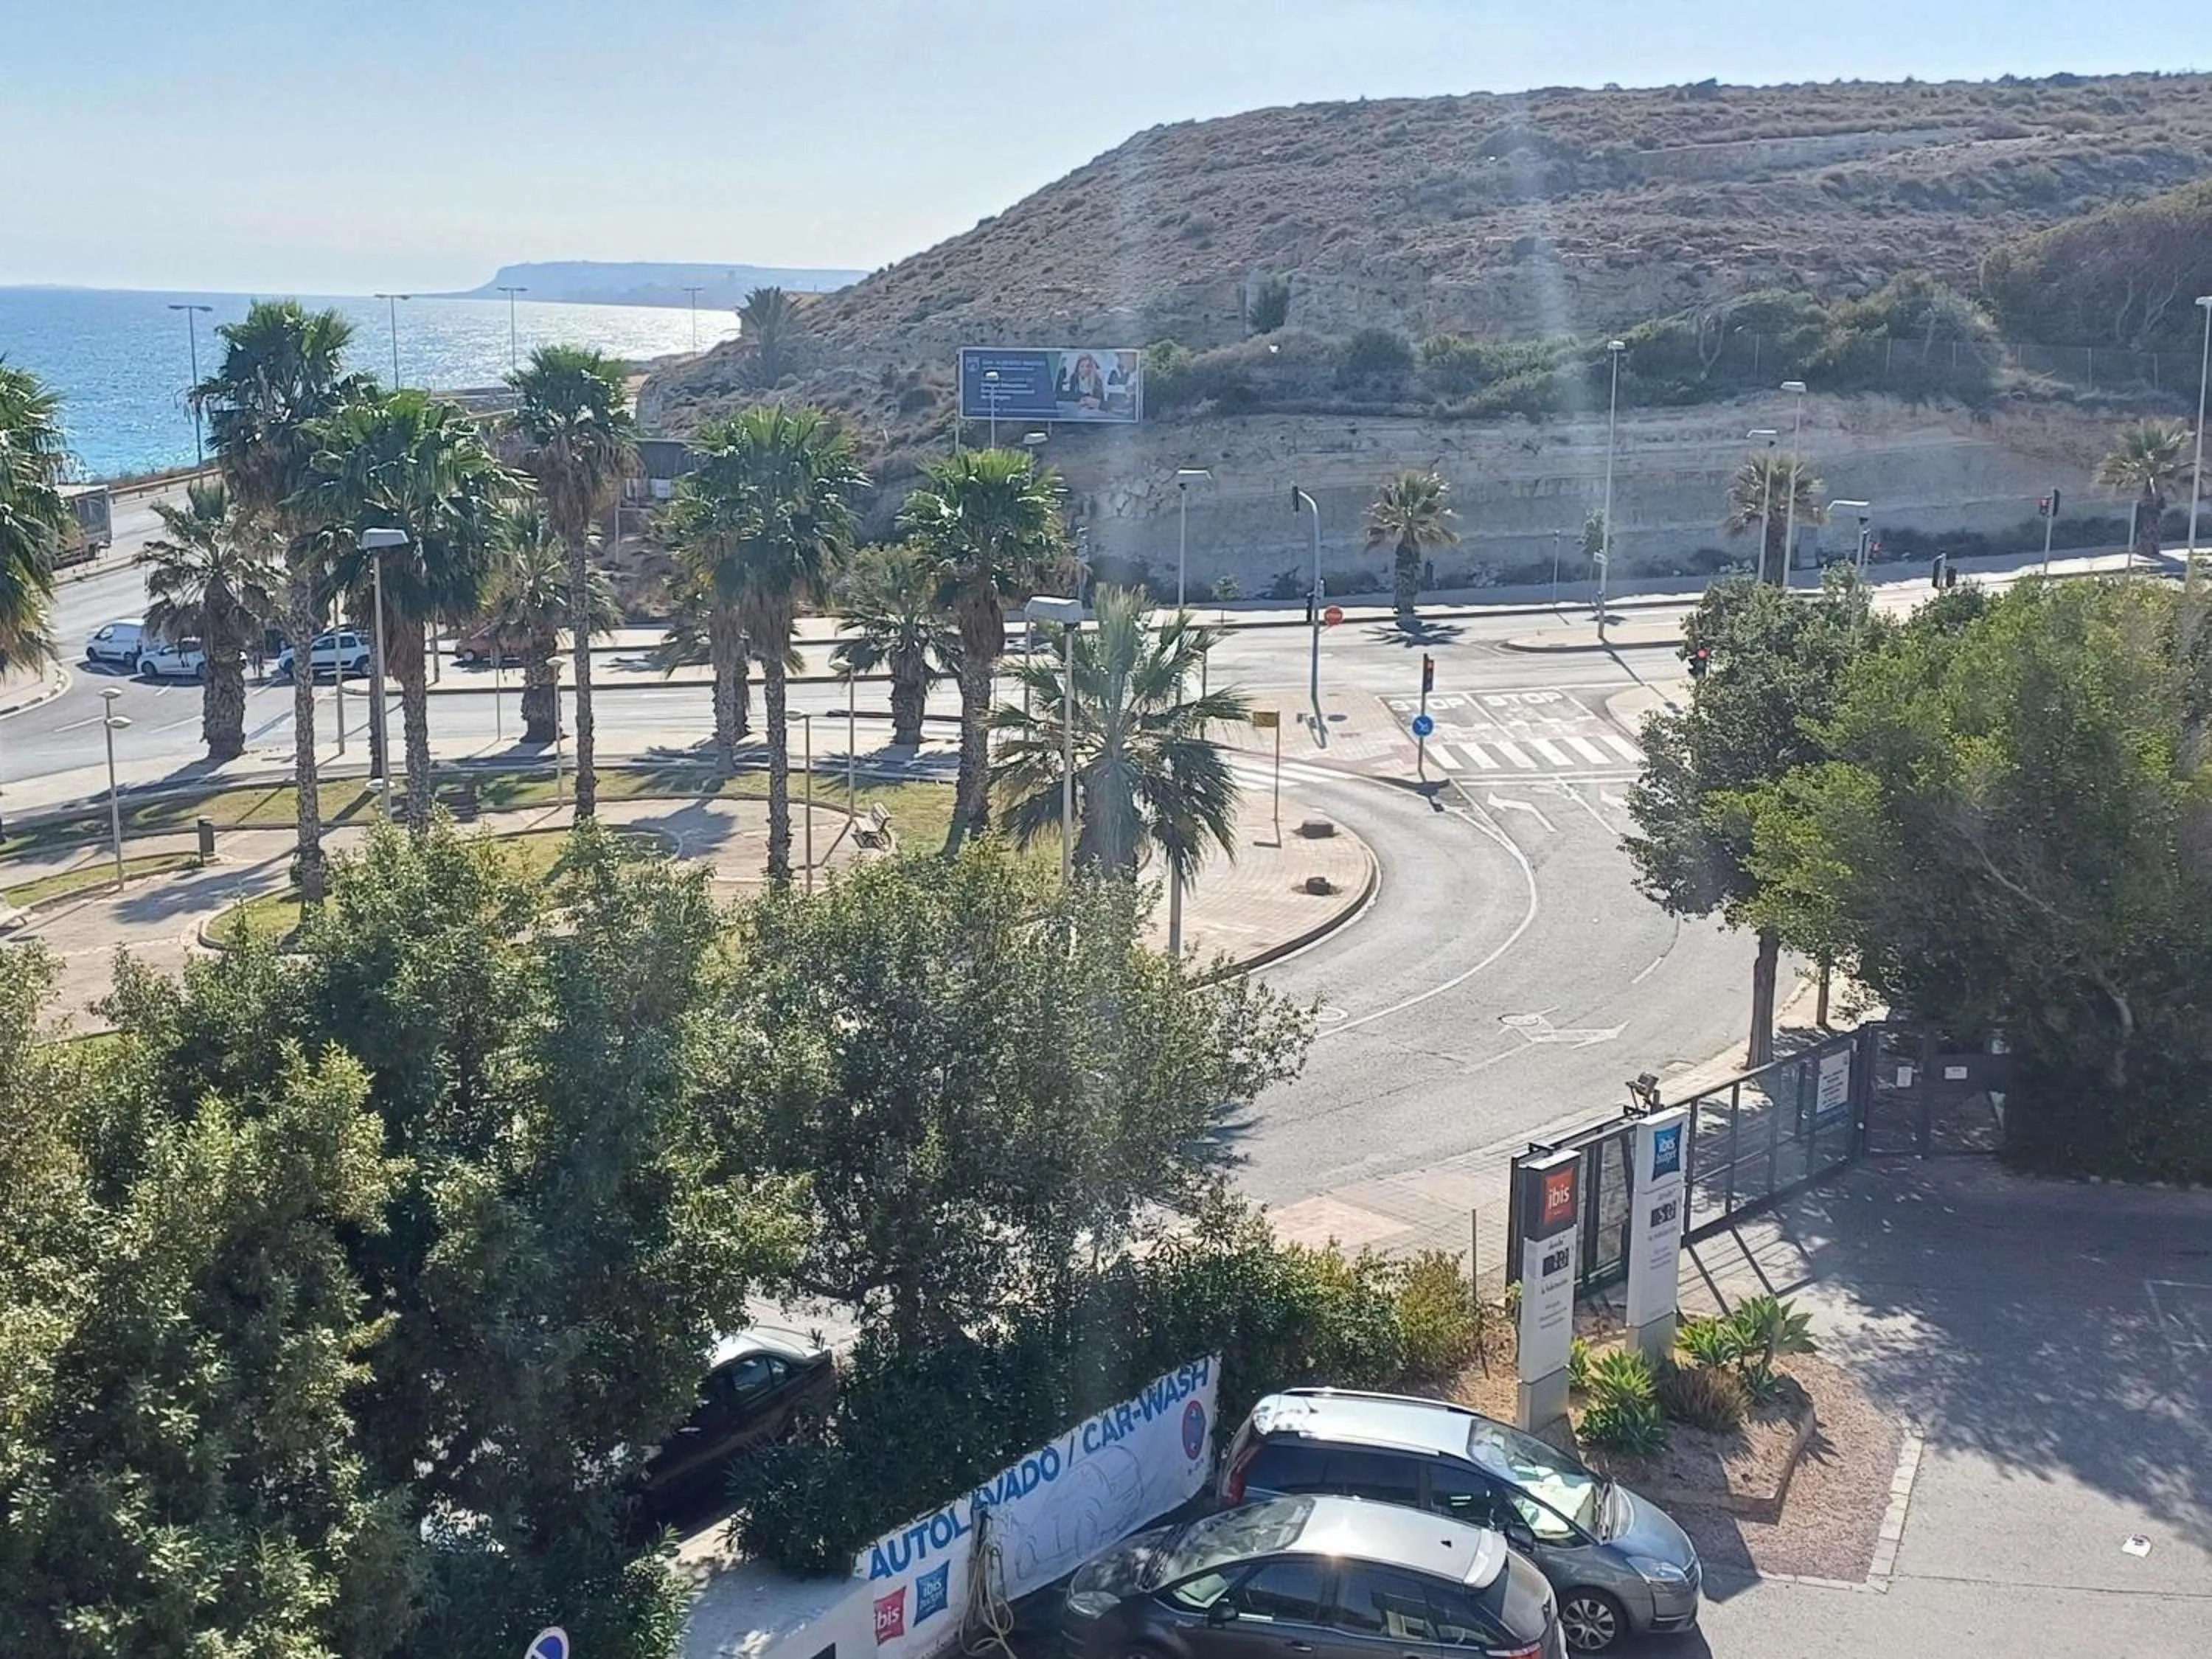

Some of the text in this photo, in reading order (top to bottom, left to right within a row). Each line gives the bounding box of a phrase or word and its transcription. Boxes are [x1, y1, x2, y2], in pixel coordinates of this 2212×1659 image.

[1388, 698, 1465, 712] STOP
[1483, 692, 1562, 706] STOP
[1548, 1183, 1570, 1210] ibis
[869, 1446, 1060, 1580] AUTOLAVADO
[1082, 1357, 1210, 1455] CAR-WASH
